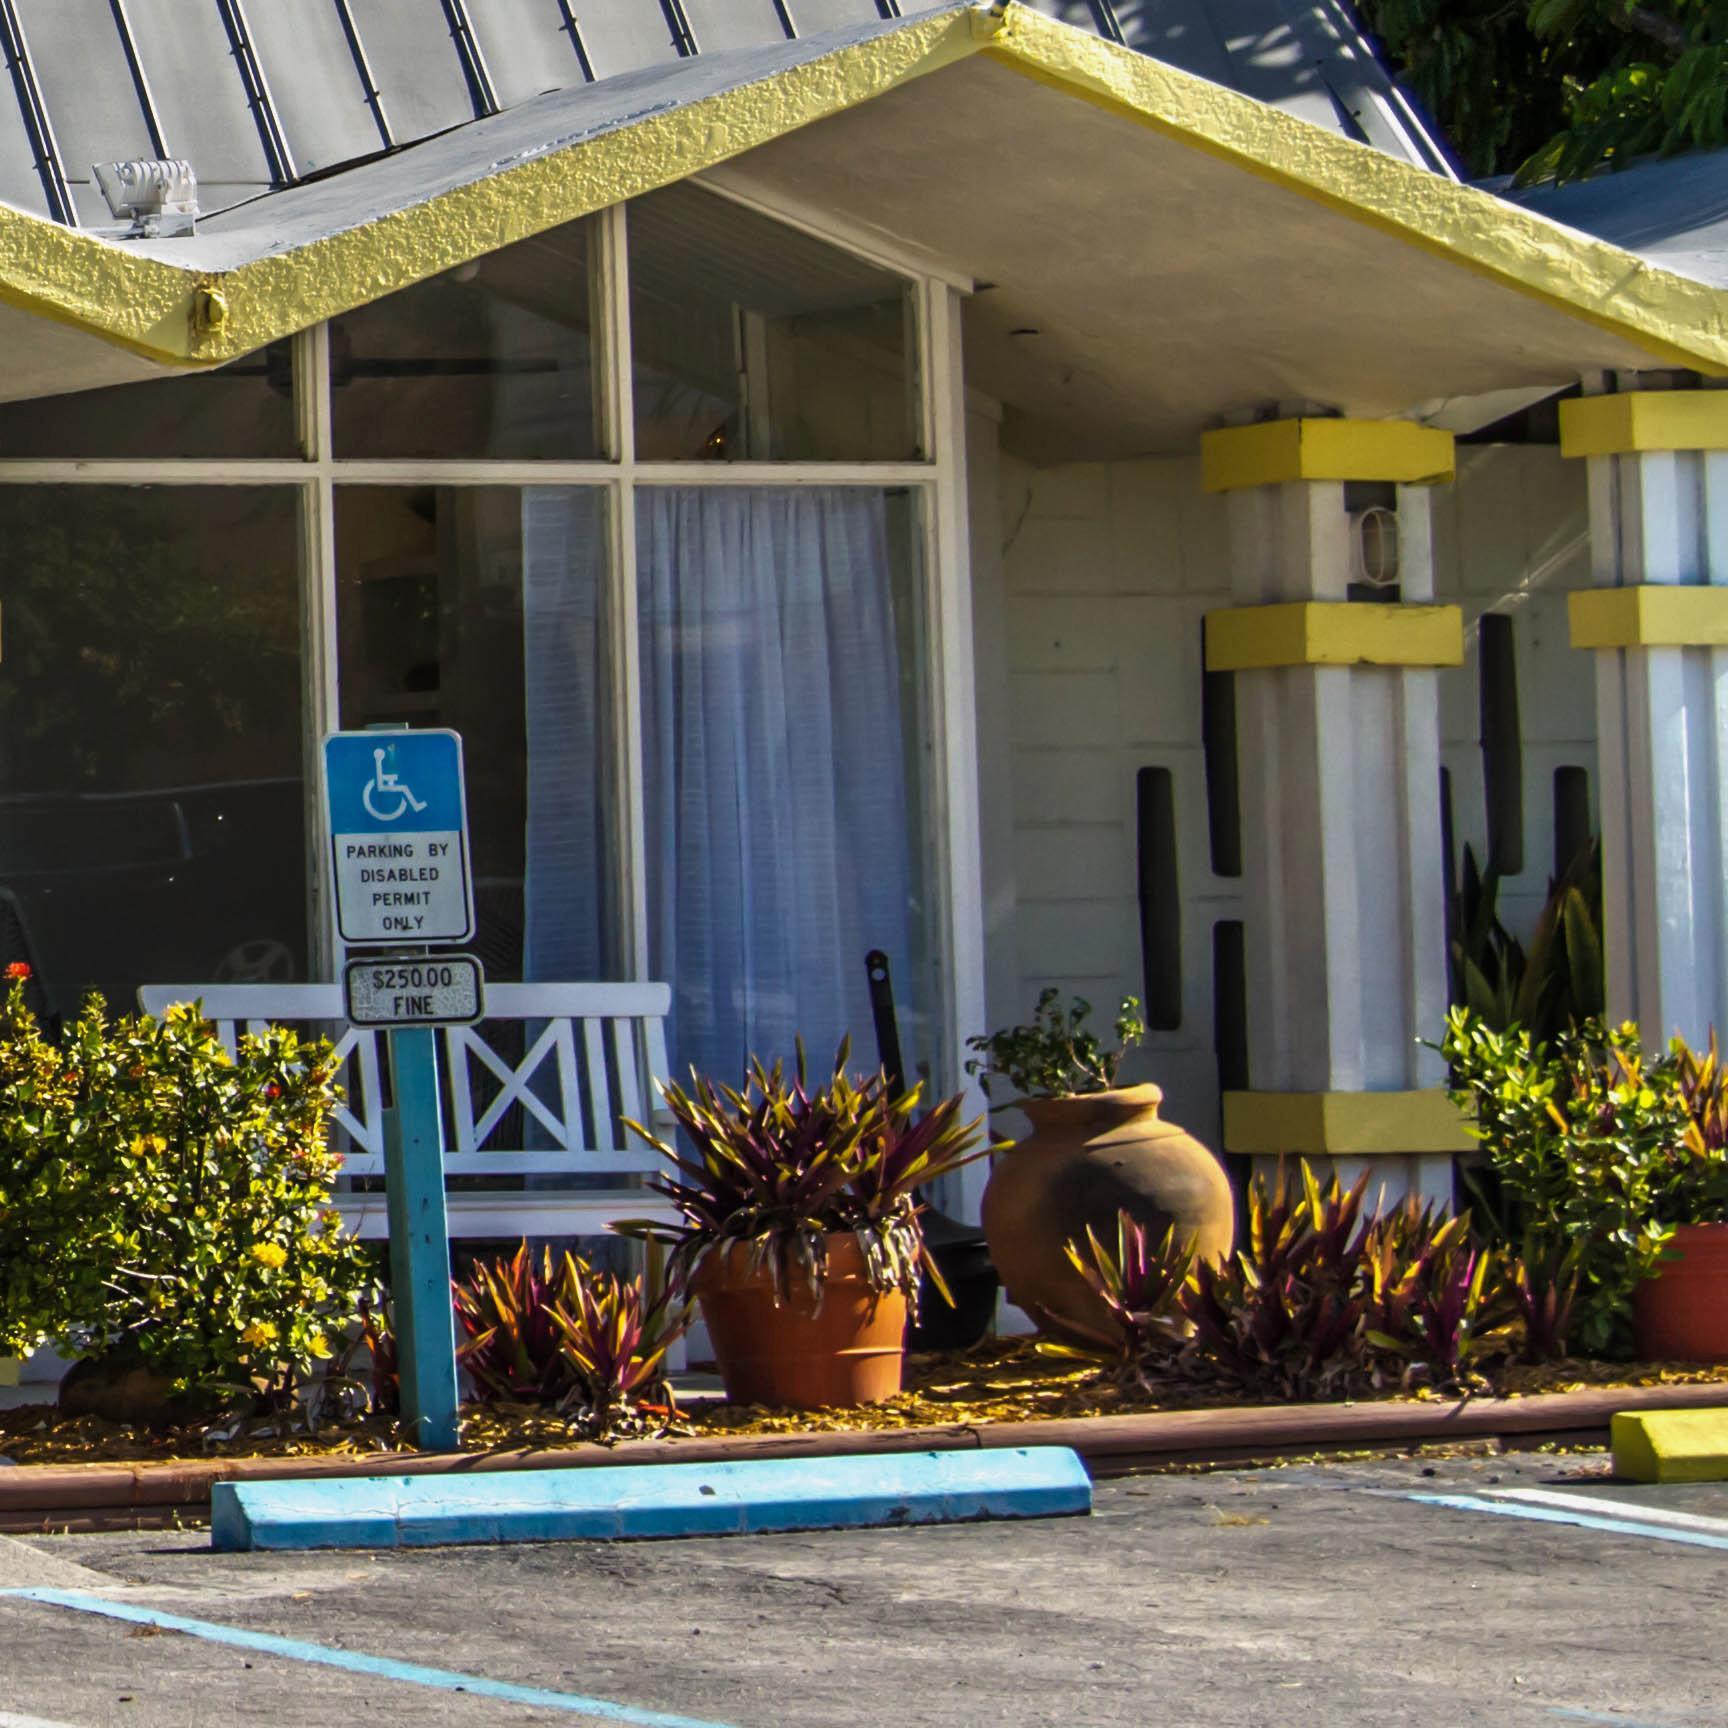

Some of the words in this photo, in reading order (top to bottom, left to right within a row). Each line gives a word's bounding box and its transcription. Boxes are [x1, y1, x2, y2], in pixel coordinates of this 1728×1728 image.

[346, 843, 414, 859] PARKING
[428, 842, 449, 857] BY
[360, 867, 440, 883] DISABLED
[372, 891, 431, 906] PERMIT
[382, 915, 424, 931] ONLY
[372, 967, 452, 991] $250.00
[393, 995, 435, 1016] FINE
